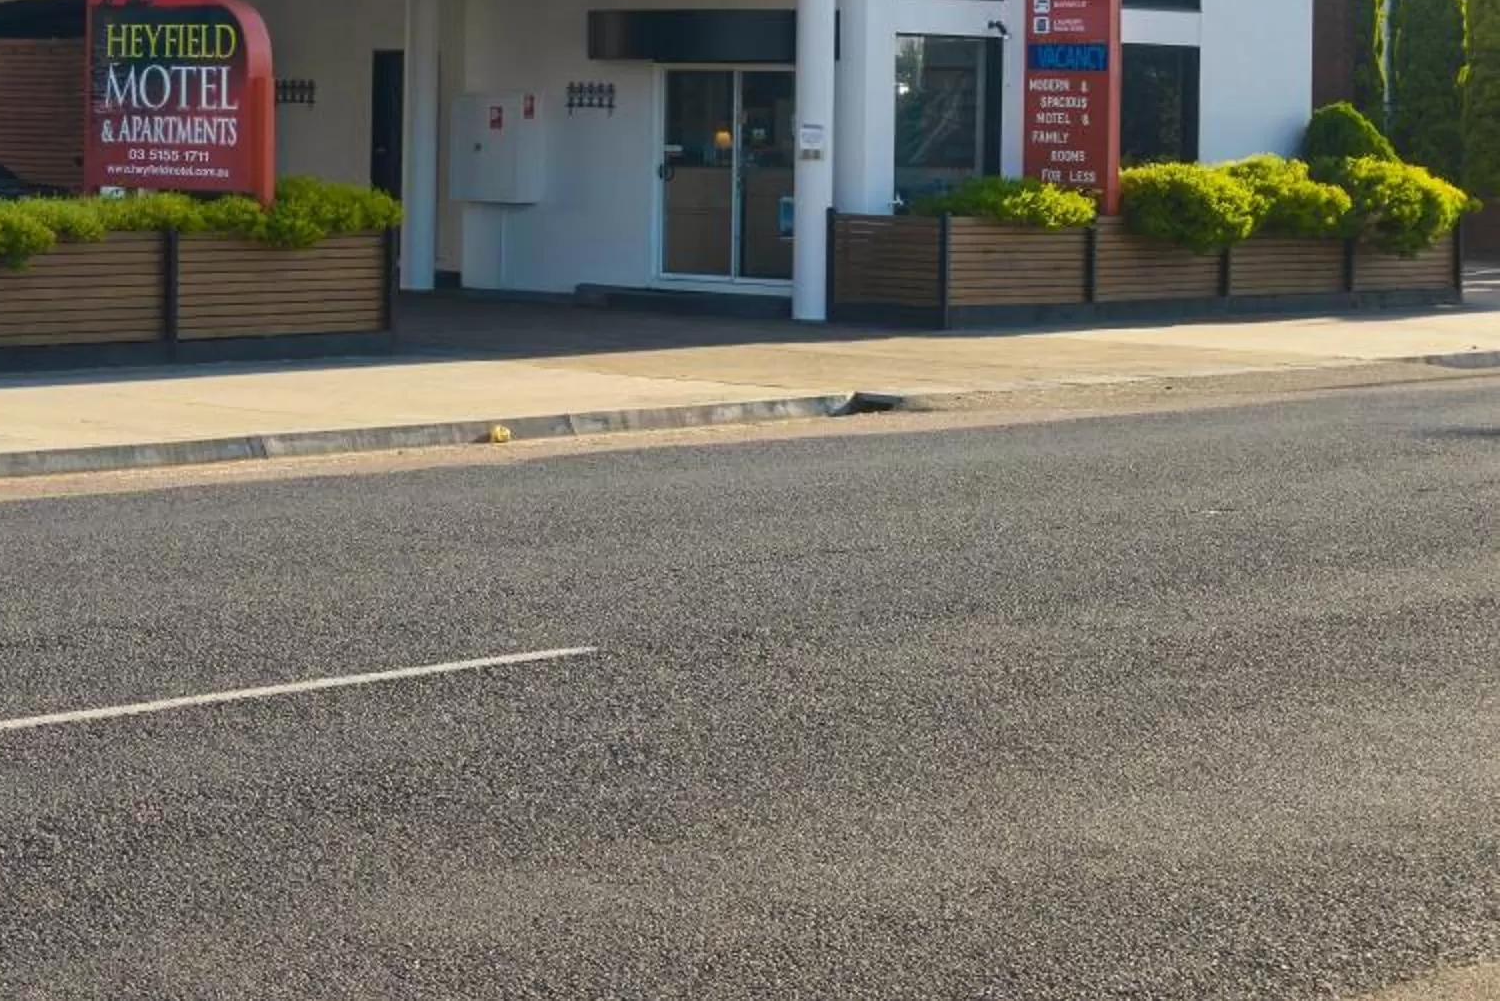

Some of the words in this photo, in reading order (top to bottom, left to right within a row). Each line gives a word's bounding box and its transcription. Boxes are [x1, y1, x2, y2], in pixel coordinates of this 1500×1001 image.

[105, 23, 237, 59] HEYFIELD
[1037, 45, 1105, 70] VACANCY
[105, 64, 239, 110] MOTEL
[1029, 78, 1070, 92] MODERN
[1040, 95, 1088, 109] SPACIOUS
[1035, 112, 1072, 125] MOTEL
[101, 119, 113, 142] &
[119, 115, 238, 146] APARTMENTS
[1031, 130, 1070, 144] FAMILY
[129, 149, 145, 160] 03
[149, 149, 180, 162] 5155
[184, 150, 209, 162] 1711
[1051, 150, 1086, 162] ROOMS
[1041, 168, 1062, 182] FOR
[1069, 170, 1097, 183] LESS
